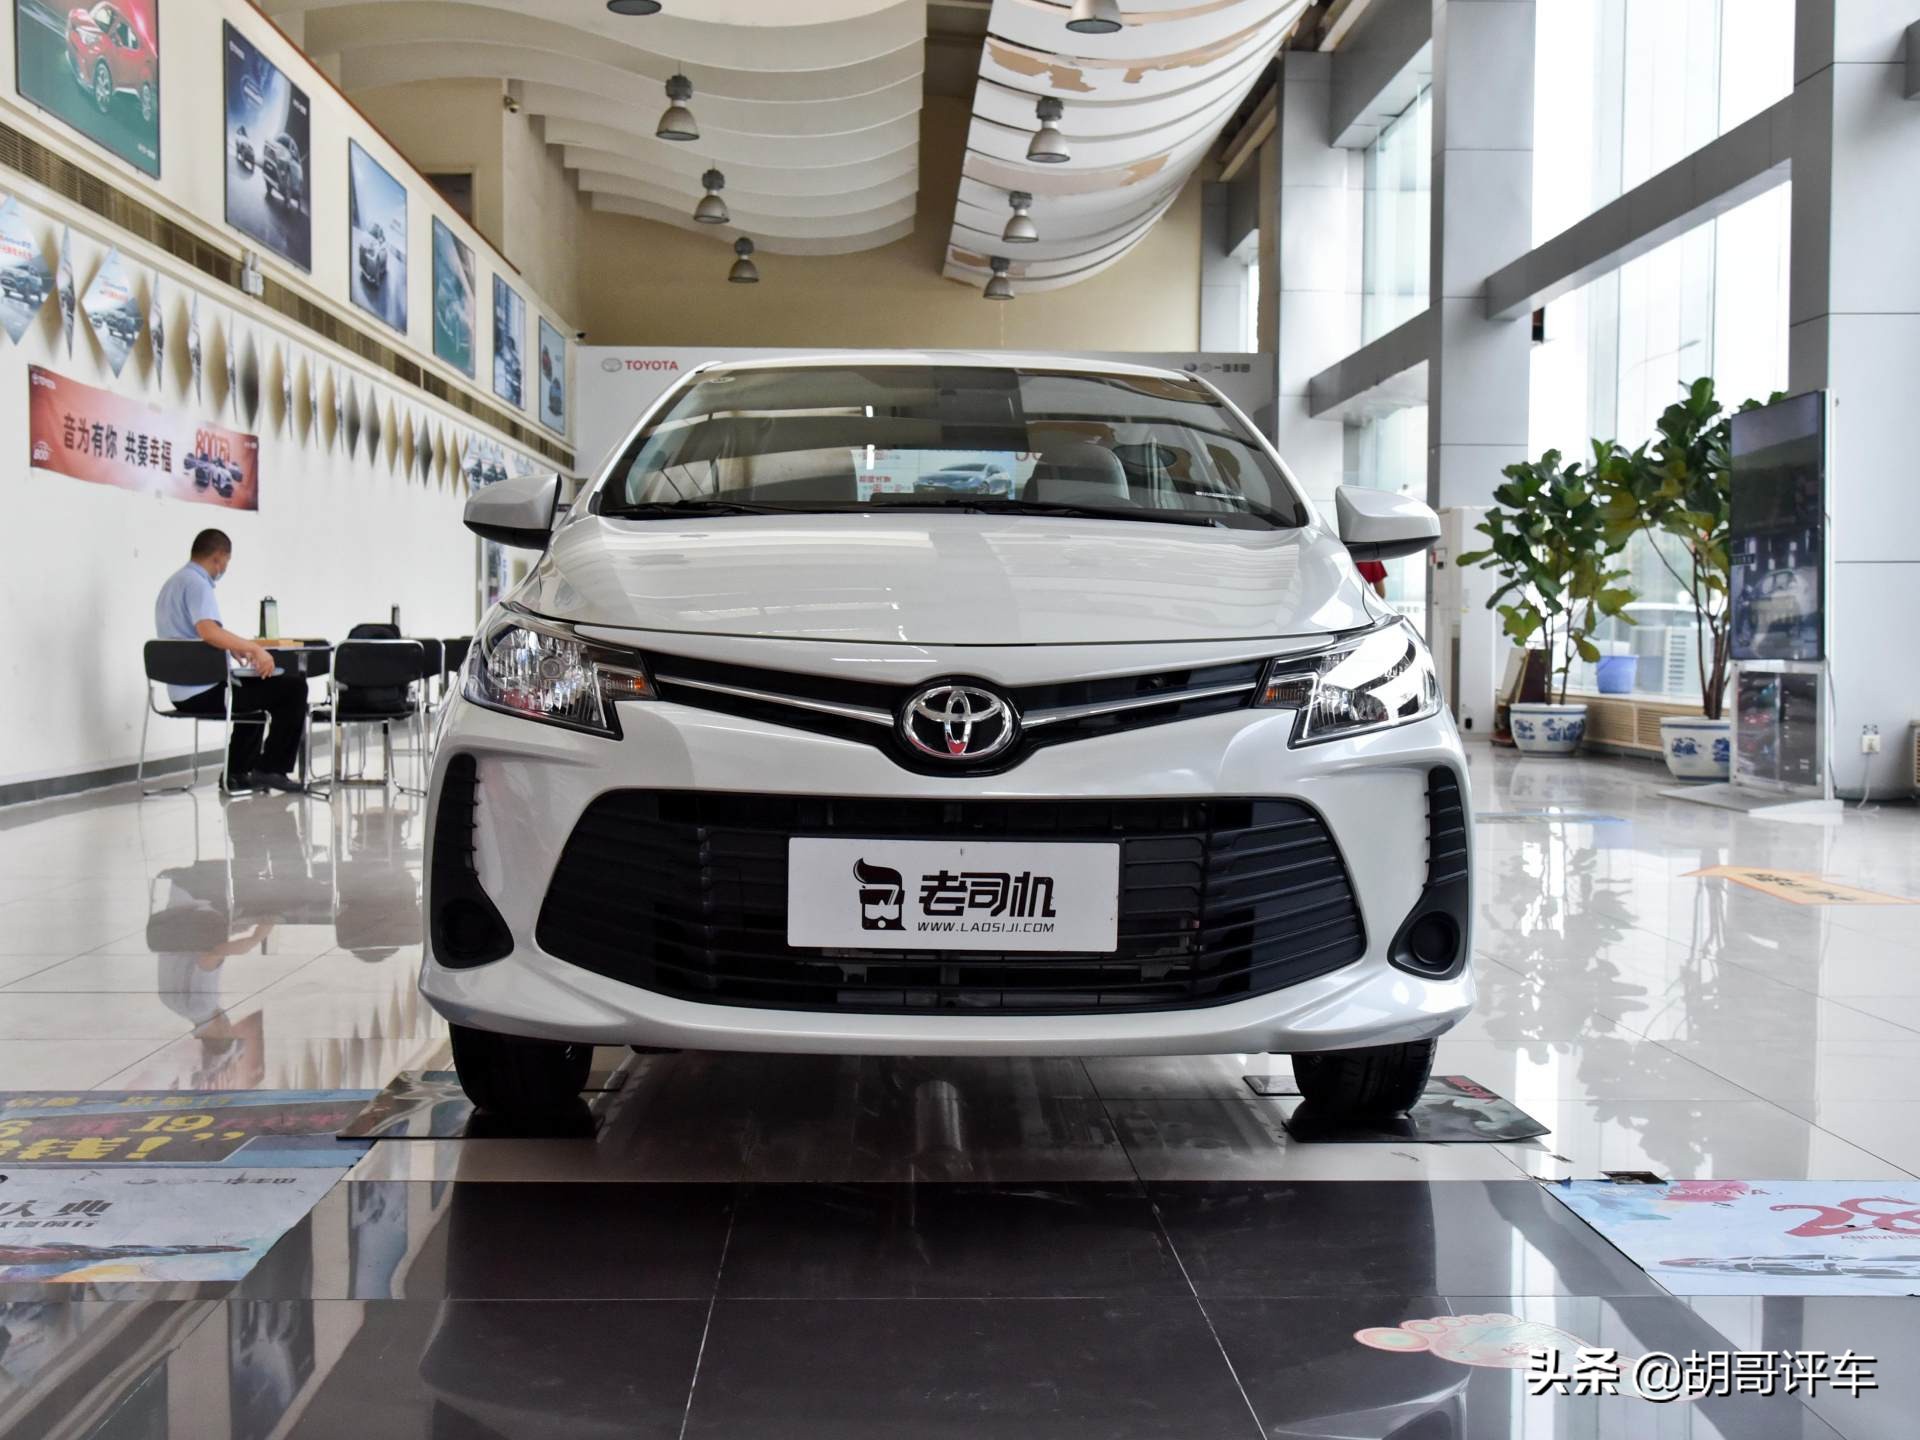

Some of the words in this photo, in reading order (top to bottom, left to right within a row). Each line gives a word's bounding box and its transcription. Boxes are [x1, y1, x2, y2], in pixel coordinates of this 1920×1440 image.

[624, 359, 680, 371] TOYOTA
[918, 870, 1056, 918] 老司机
[917, 921, 1055, 933] WWW.LAOSIJI.COM
